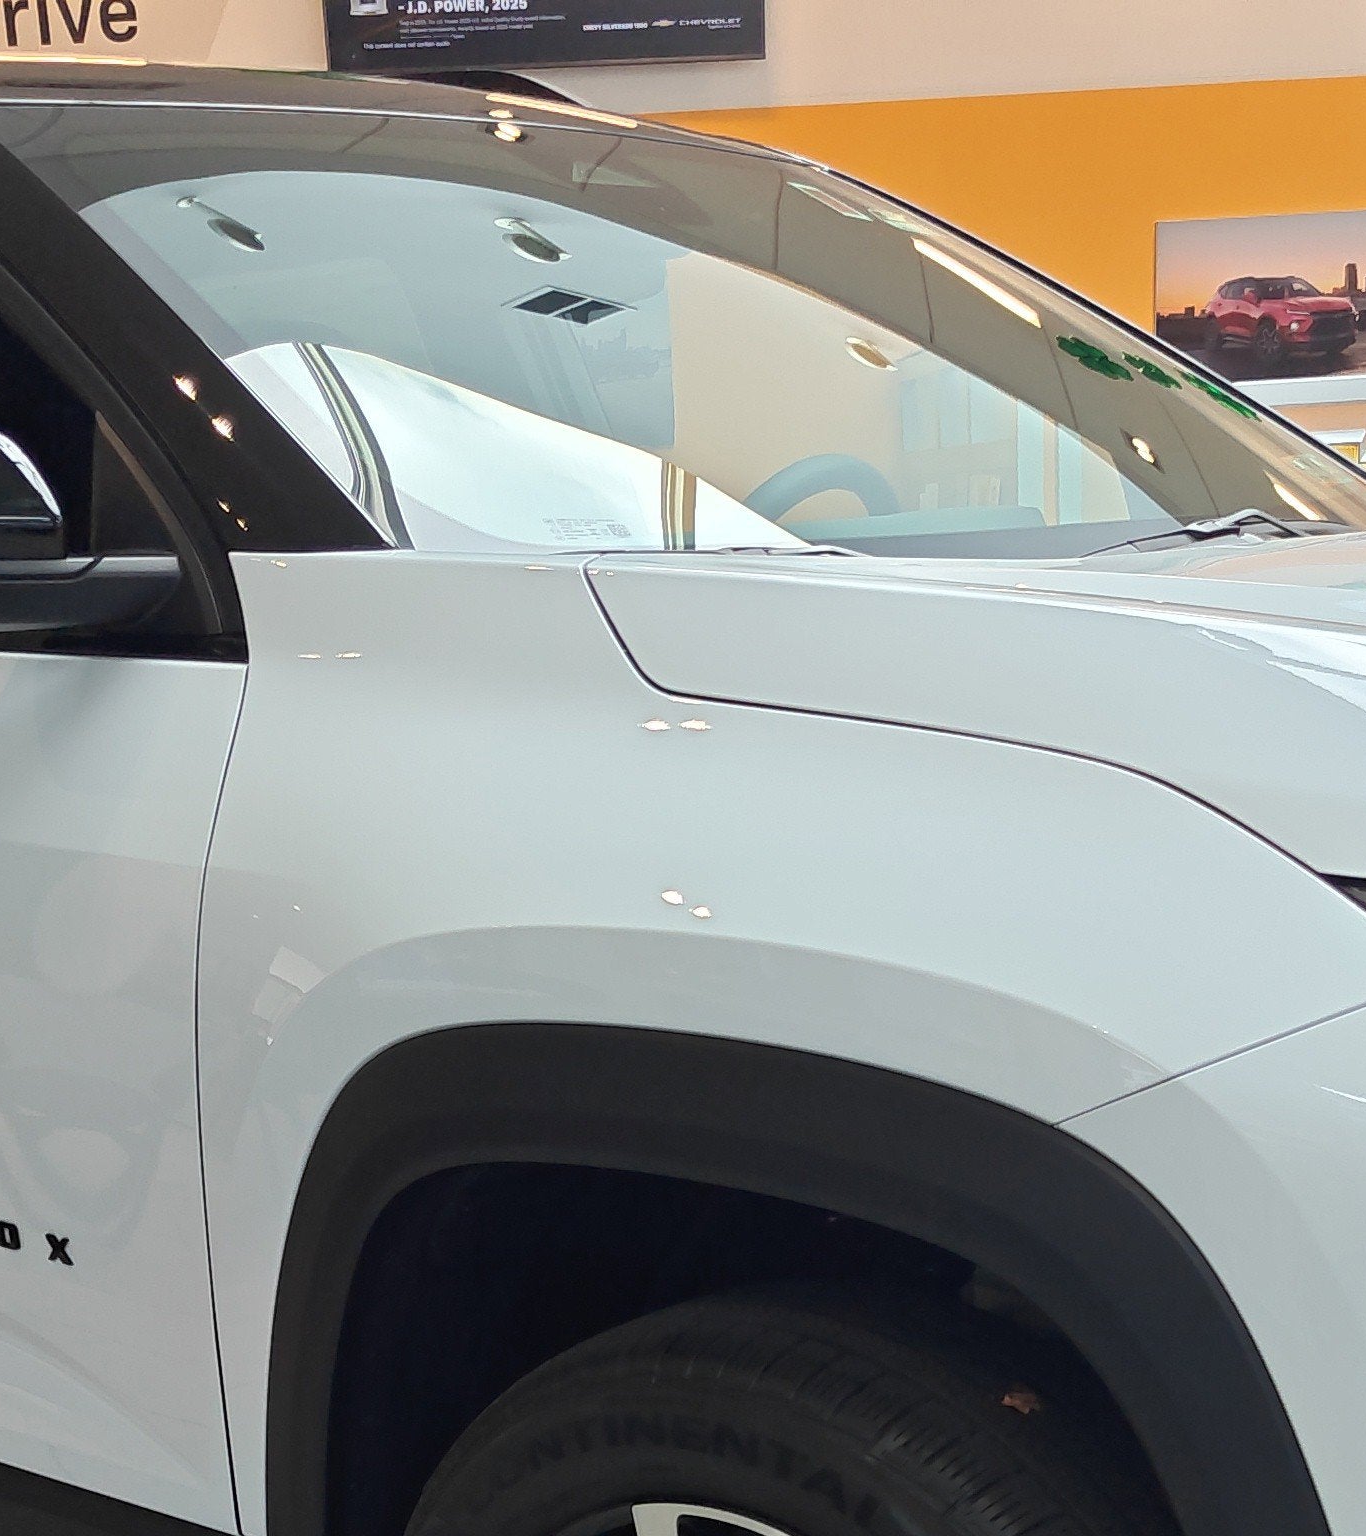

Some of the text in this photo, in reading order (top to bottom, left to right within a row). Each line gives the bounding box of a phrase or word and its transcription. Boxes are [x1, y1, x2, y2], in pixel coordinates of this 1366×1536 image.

[407, 0, 432, 14] J.D.
[434, 0, 489, 14] POWER,
[491, 0, 528, 11] 2025
